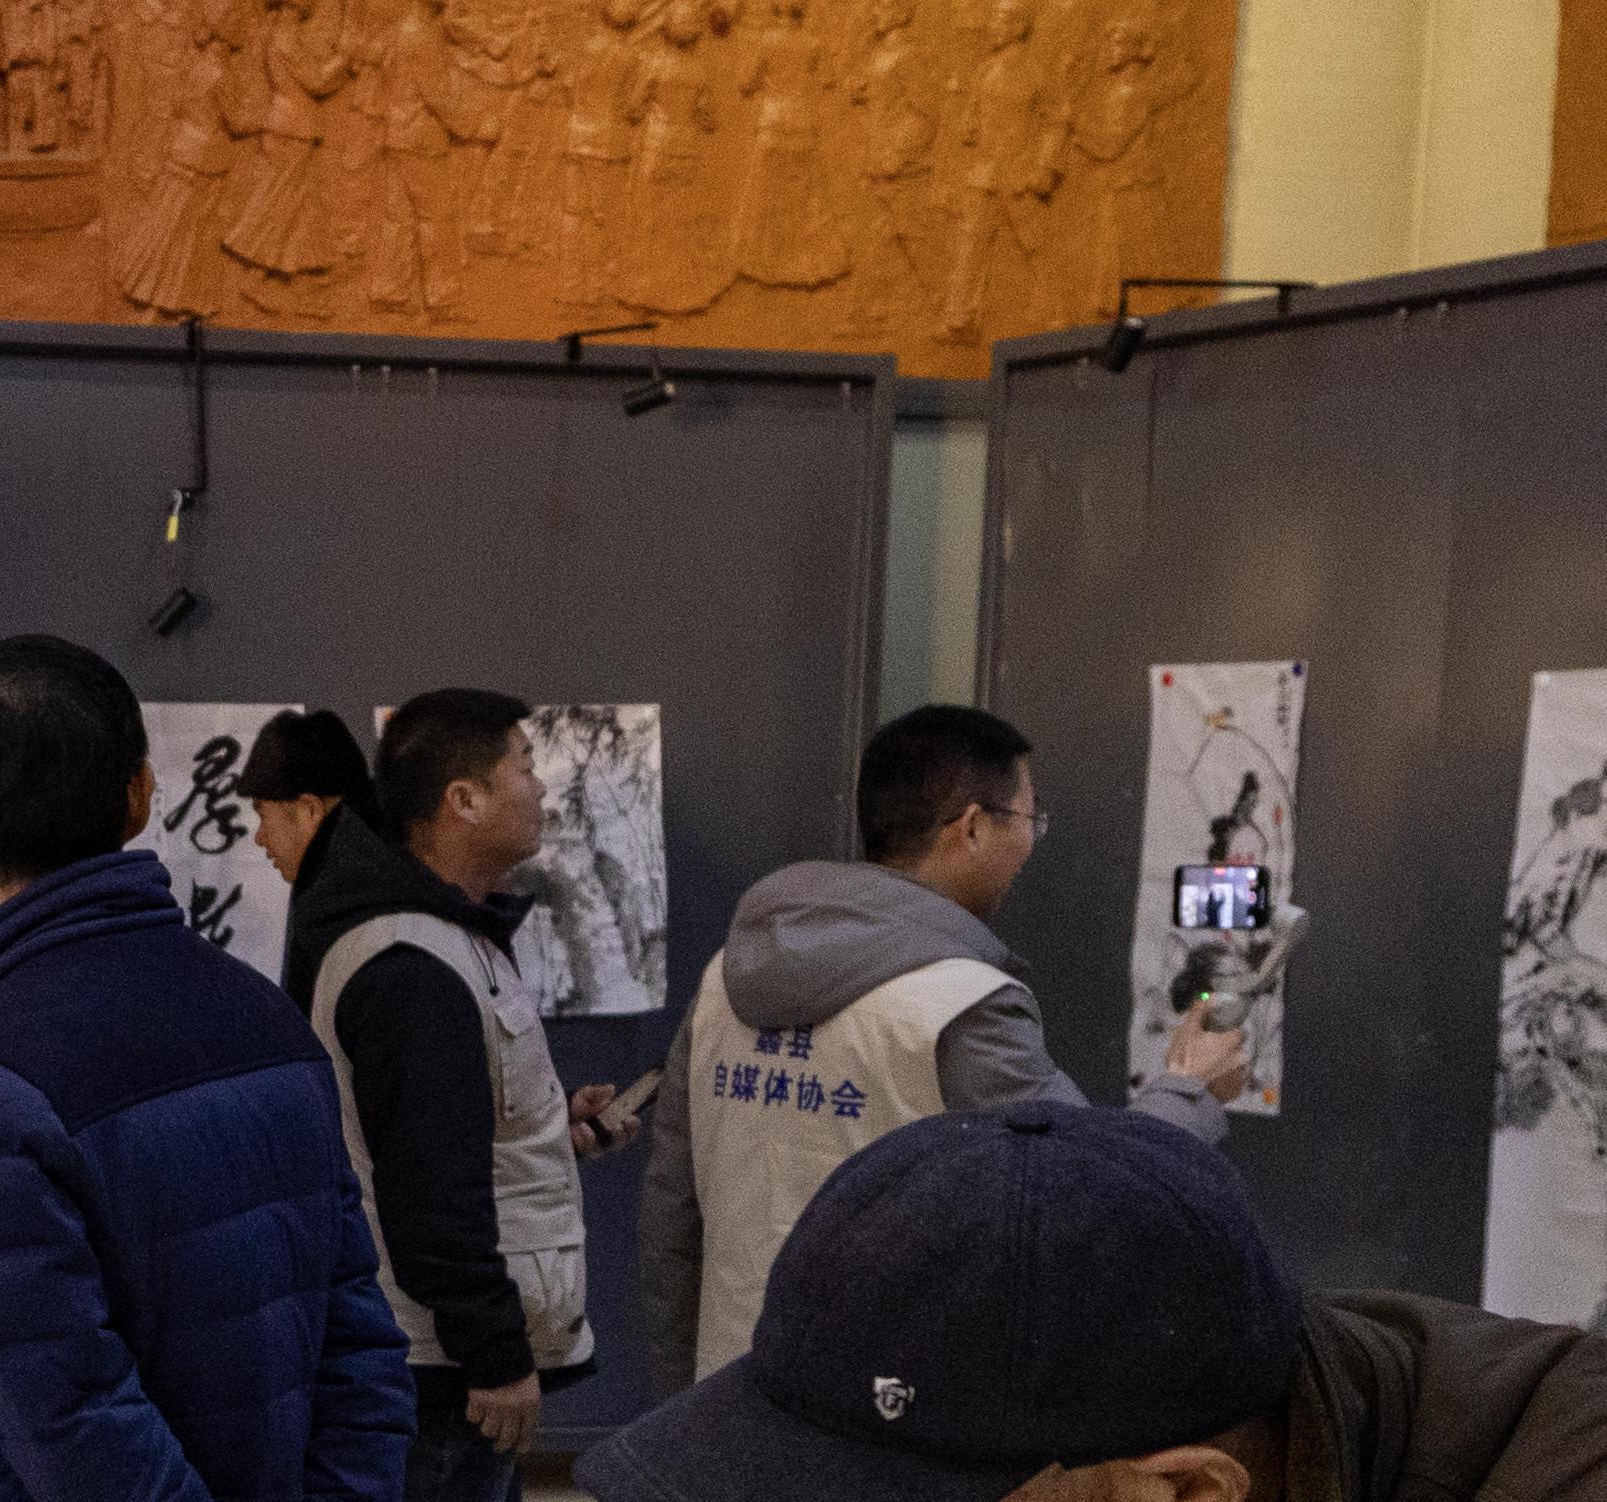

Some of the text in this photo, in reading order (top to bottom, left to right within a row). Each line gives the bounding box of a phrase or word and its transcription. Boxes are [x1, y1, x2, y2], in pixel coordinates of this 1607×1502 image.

[714, 1060, 867, 1118] 自媒体协会
